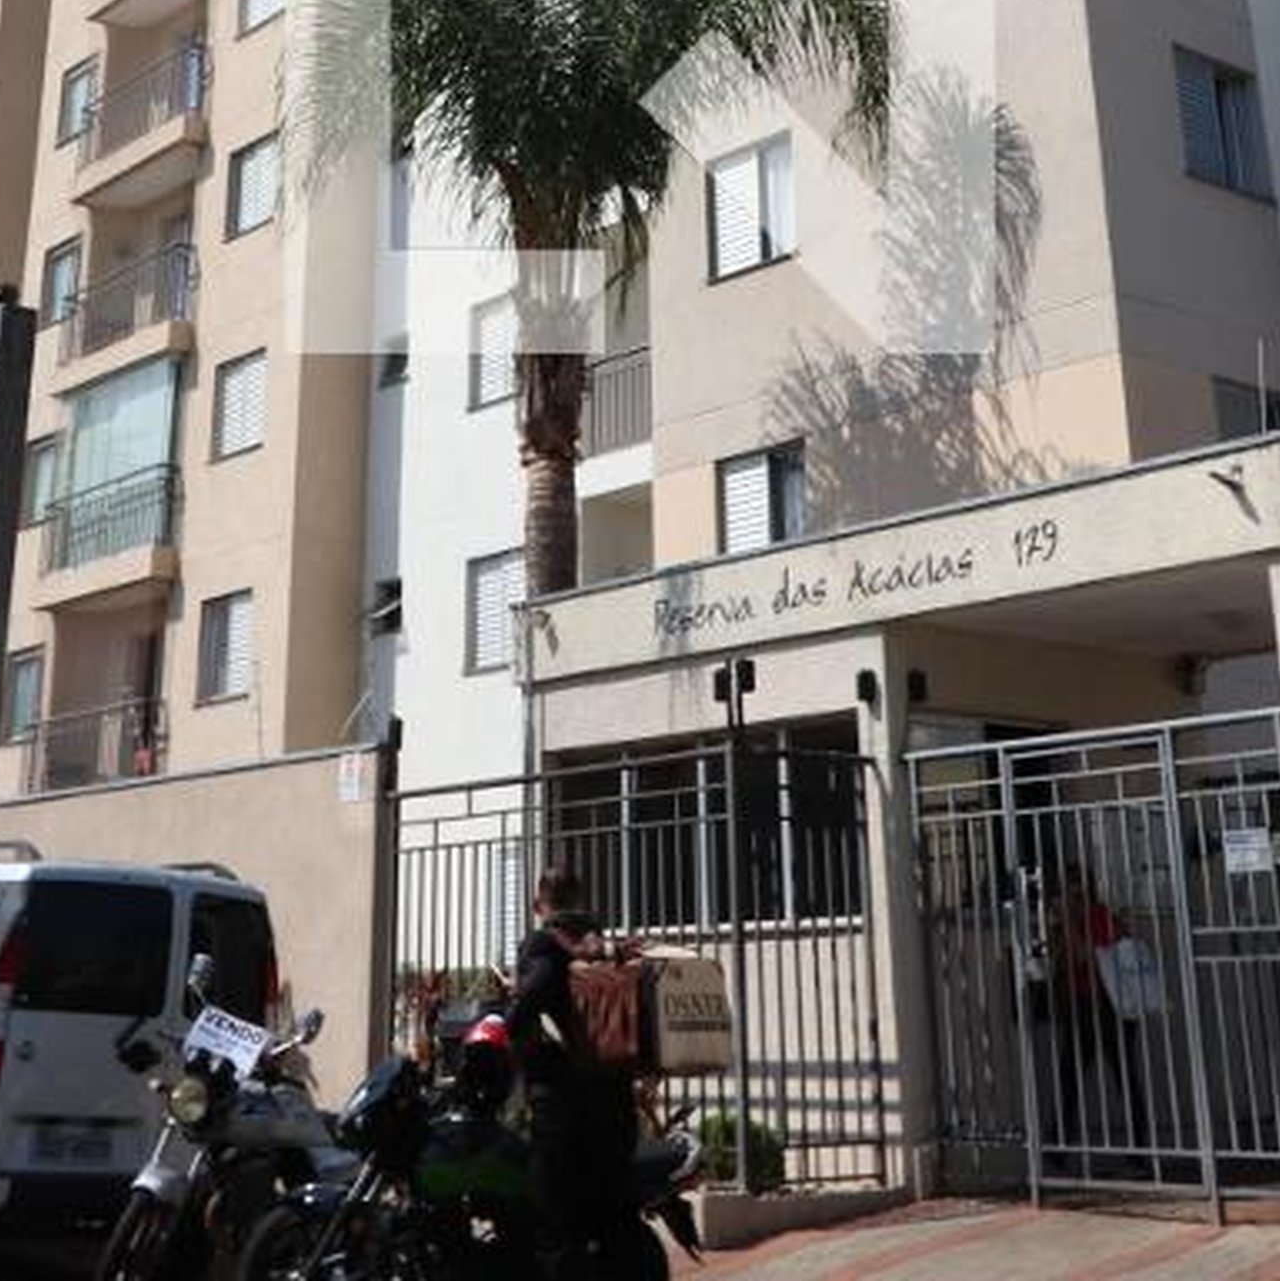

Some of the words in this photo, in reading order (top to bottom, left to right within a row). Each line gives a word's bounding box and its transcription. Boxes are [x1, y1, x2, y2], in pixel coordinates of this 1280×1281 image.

[654, 595, 756, 635] Reserva
[772, 567, 827, 615] das
[204, 1010, 264, 1045] VENDO
